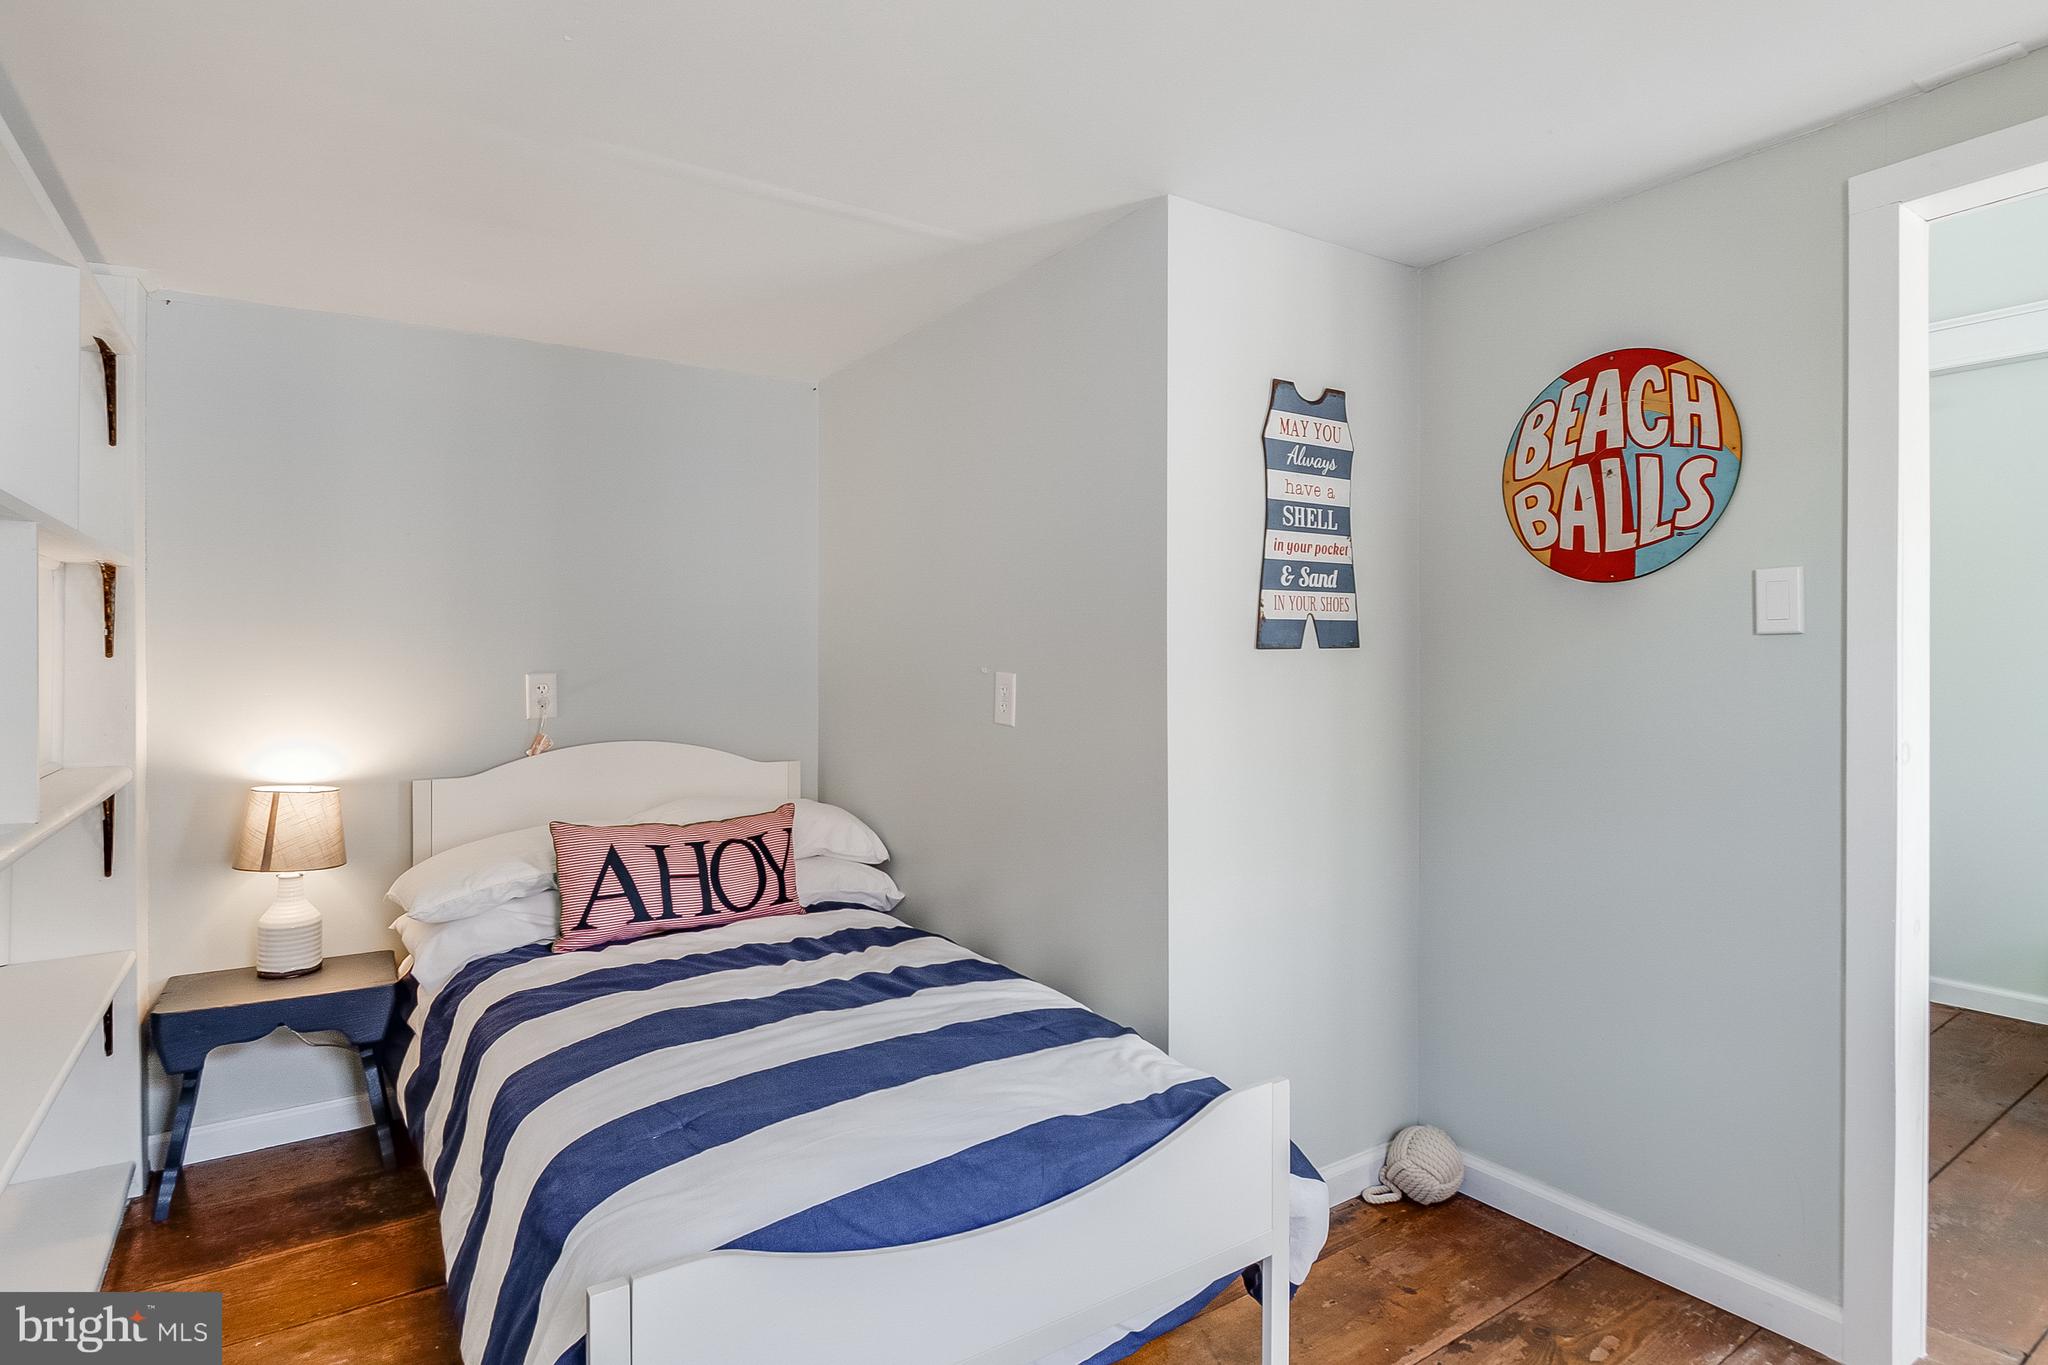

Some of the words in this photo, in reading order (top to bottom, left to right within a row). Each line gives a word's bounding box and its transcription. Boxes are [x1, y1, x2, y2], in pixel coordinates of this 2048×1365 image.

[1279, 417, 1309, 438] MAY
[1313, 422, 1342, 443] YOU
[1512, 364, 1723, 482] BEACH
[1286, 444, 1338, 475] Always
[1284, 478, 1321, 498] have
[1326, 487, 1336, 500] a
[1512, 454, 1718, 553] BALLS
[1282, 505, 1338, 531] SHELL
[1273, 537, 1285, 552] in
[1285, 540, 1313, 556] your
[1314, 540, 1349, 557] pocket
[1280, 565, 1295, 587] &
[1298, 566, 1338, 589] Sand
[1273, 594, 1285, 611] IN
[1288, 595, 1317, 612] YOUR
[1320, 596, 1350, 613] SHOES
[570, 828, 793, 930] AHOY
